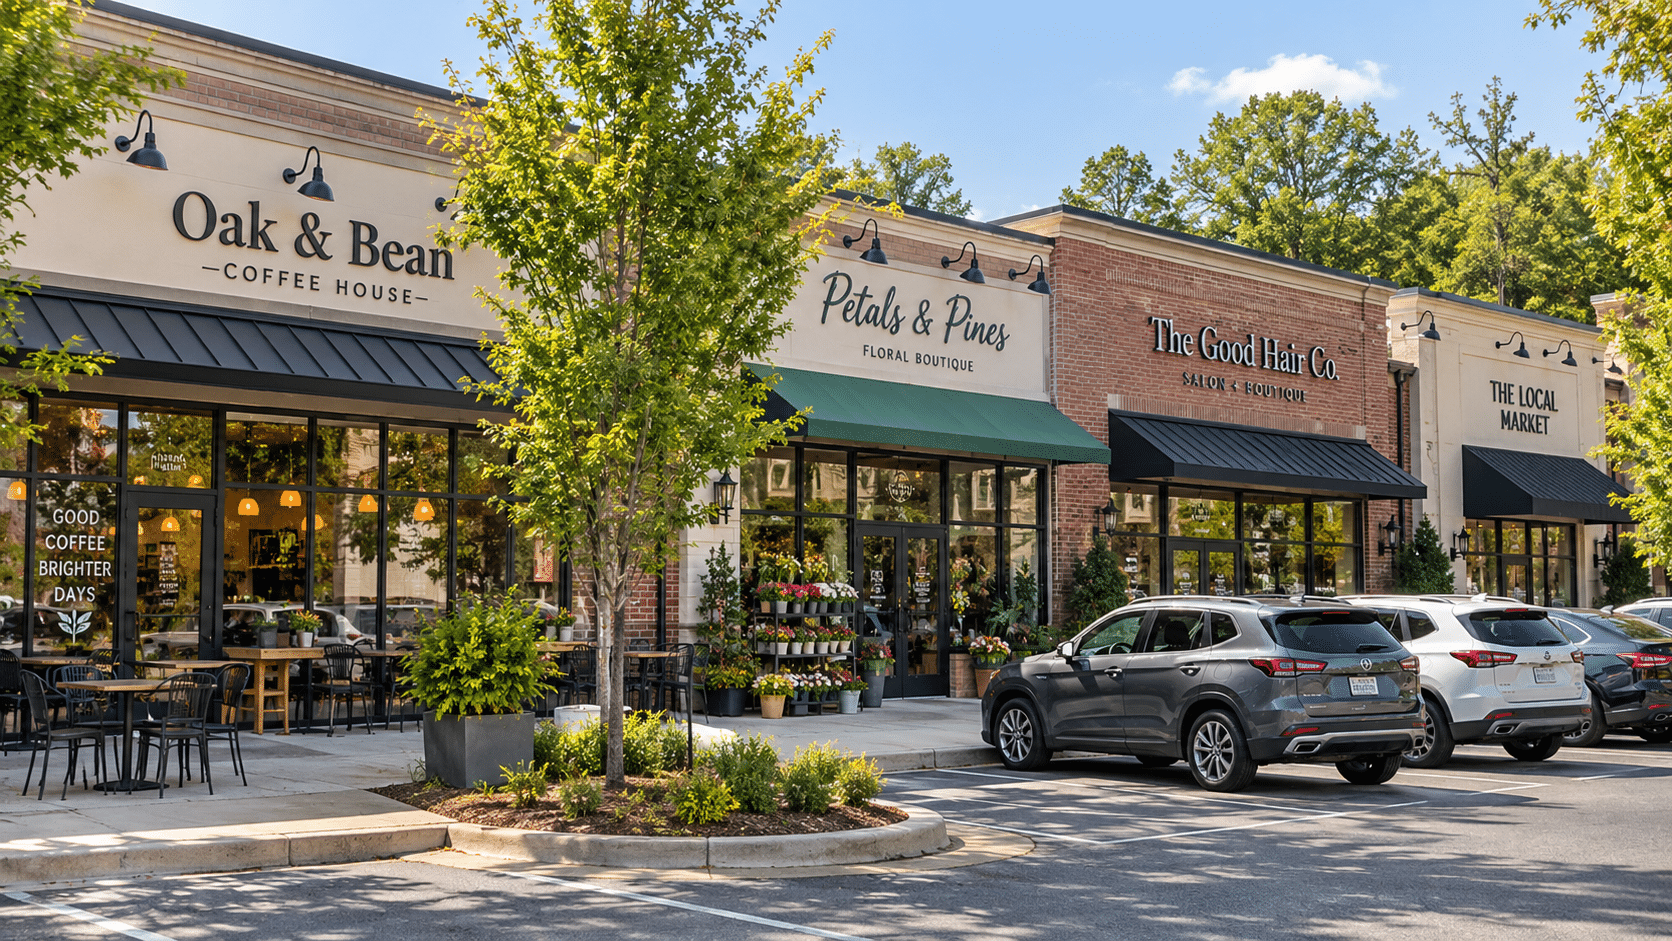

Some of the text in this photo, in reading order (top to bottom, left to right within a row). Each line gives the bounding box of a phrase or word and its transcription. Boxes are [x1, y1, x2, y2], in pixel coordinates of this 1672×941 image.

[172, 190, 455, 281] Oak & Bean
[223, 262, 413, 305] COFFEE HOUSE
[821, 270, 1010, 352] Petals & Pines
[863, 344, 974, 372] FLORAL BOUTIQUE
[1148, 316, 1340, 381] The Good Hair Co.
[1182, 371, 1226, 391] SALON
[1244, 380, 1307, 403] BOUTIQUE
[1490, 379, 1559, 412] THE LOCAL
[1500, 409, 1550, 435] MARKET
[52, 508, 100, 526] GOOD
[45, 534, 106, 552] COFFEE
[38, 560, 112, 578] BRIGHTER
[54, 586, 96, 603] DAYS
